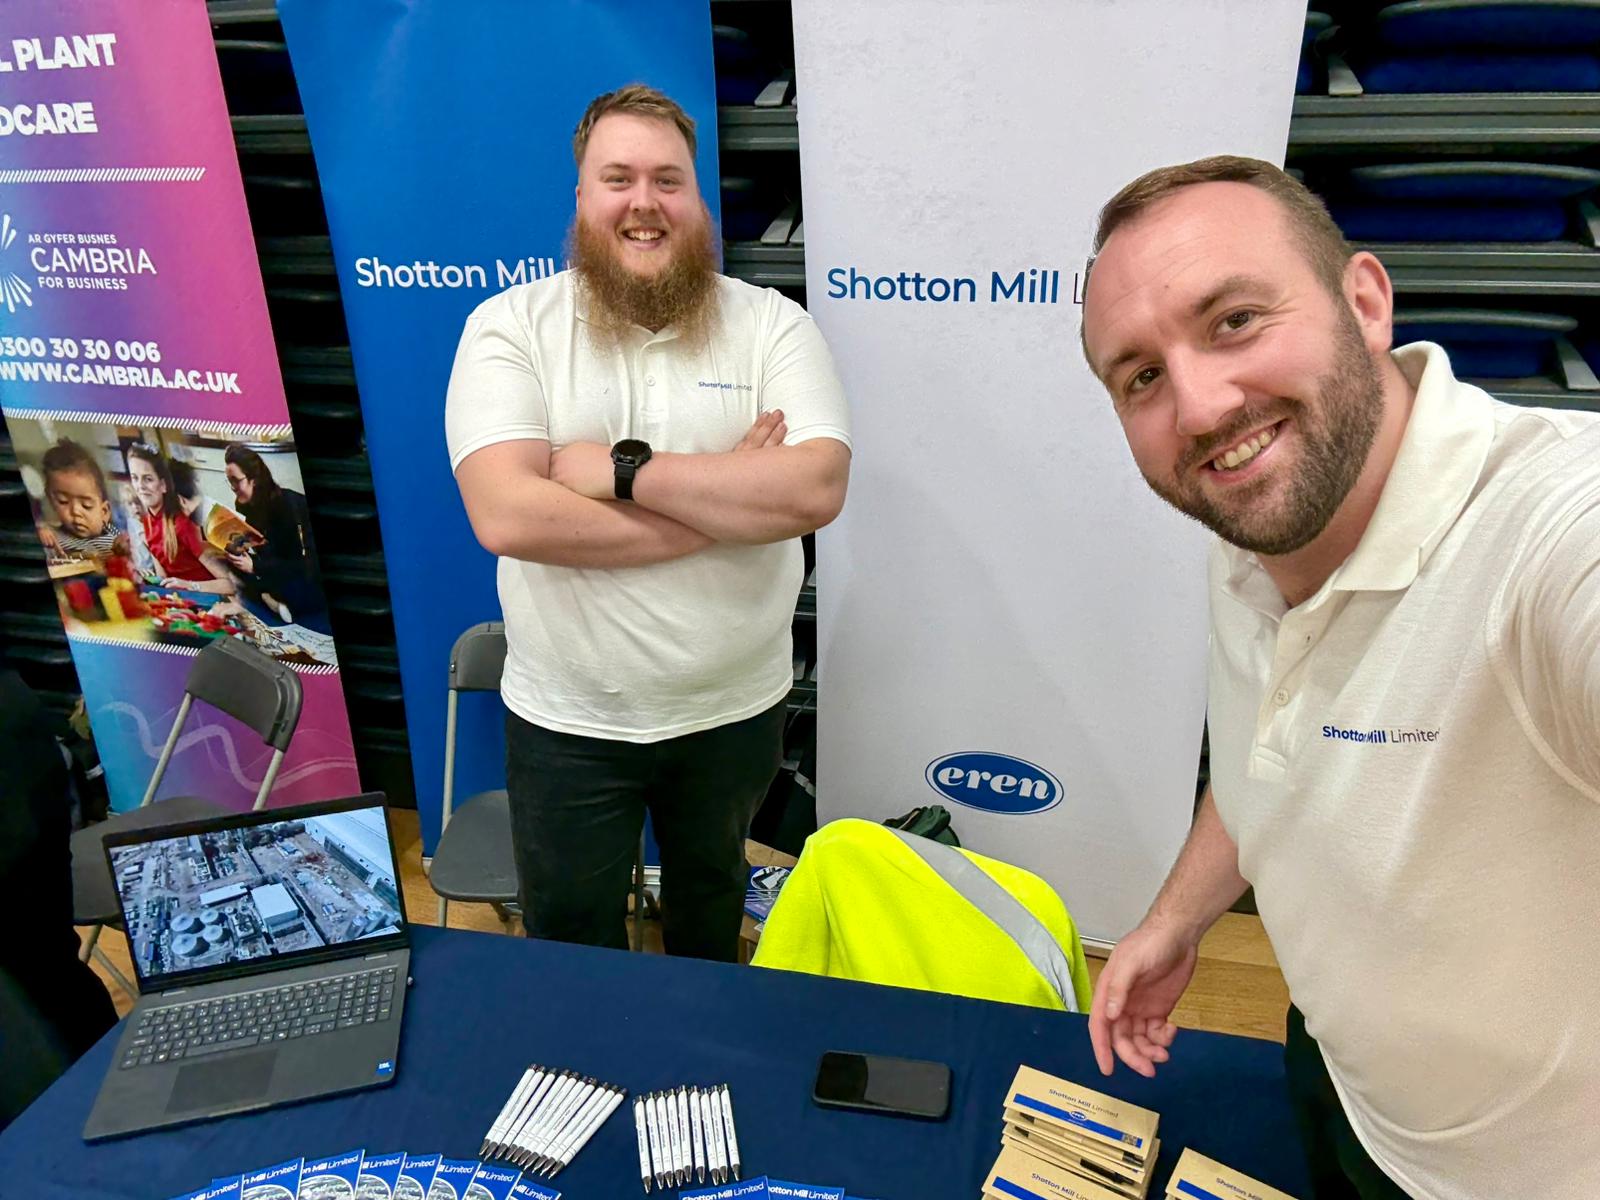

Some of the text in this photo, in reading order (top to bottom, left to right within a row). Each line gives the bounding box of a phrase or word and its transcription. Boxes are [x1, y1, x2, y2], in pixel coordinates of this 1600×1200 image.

[12, 33, 117, 71] PLANT
[28, 233, 117, 244] AR GYFER BUSNES
[31, 247, 157, 275] CAMBRIA
[355, 257, 555, 288] Shotton Mill
[38, 277, 128, 290] FOR BUSINESS
[828, 267, 976, 303] Shotton
[991, 268, 1059, 304] Mill
[0, 336, 161, 363] 300 30 30 006
[0, 361, 242, 394] WWW.CAMBRIA.AC.UK
[937, 766, 1050, 801] eren
[718, 1189, 733, 1199] Mill
[733, 1181, 765, 1197] Limited
[1031, 1172, 1060, 1190] Shotton
